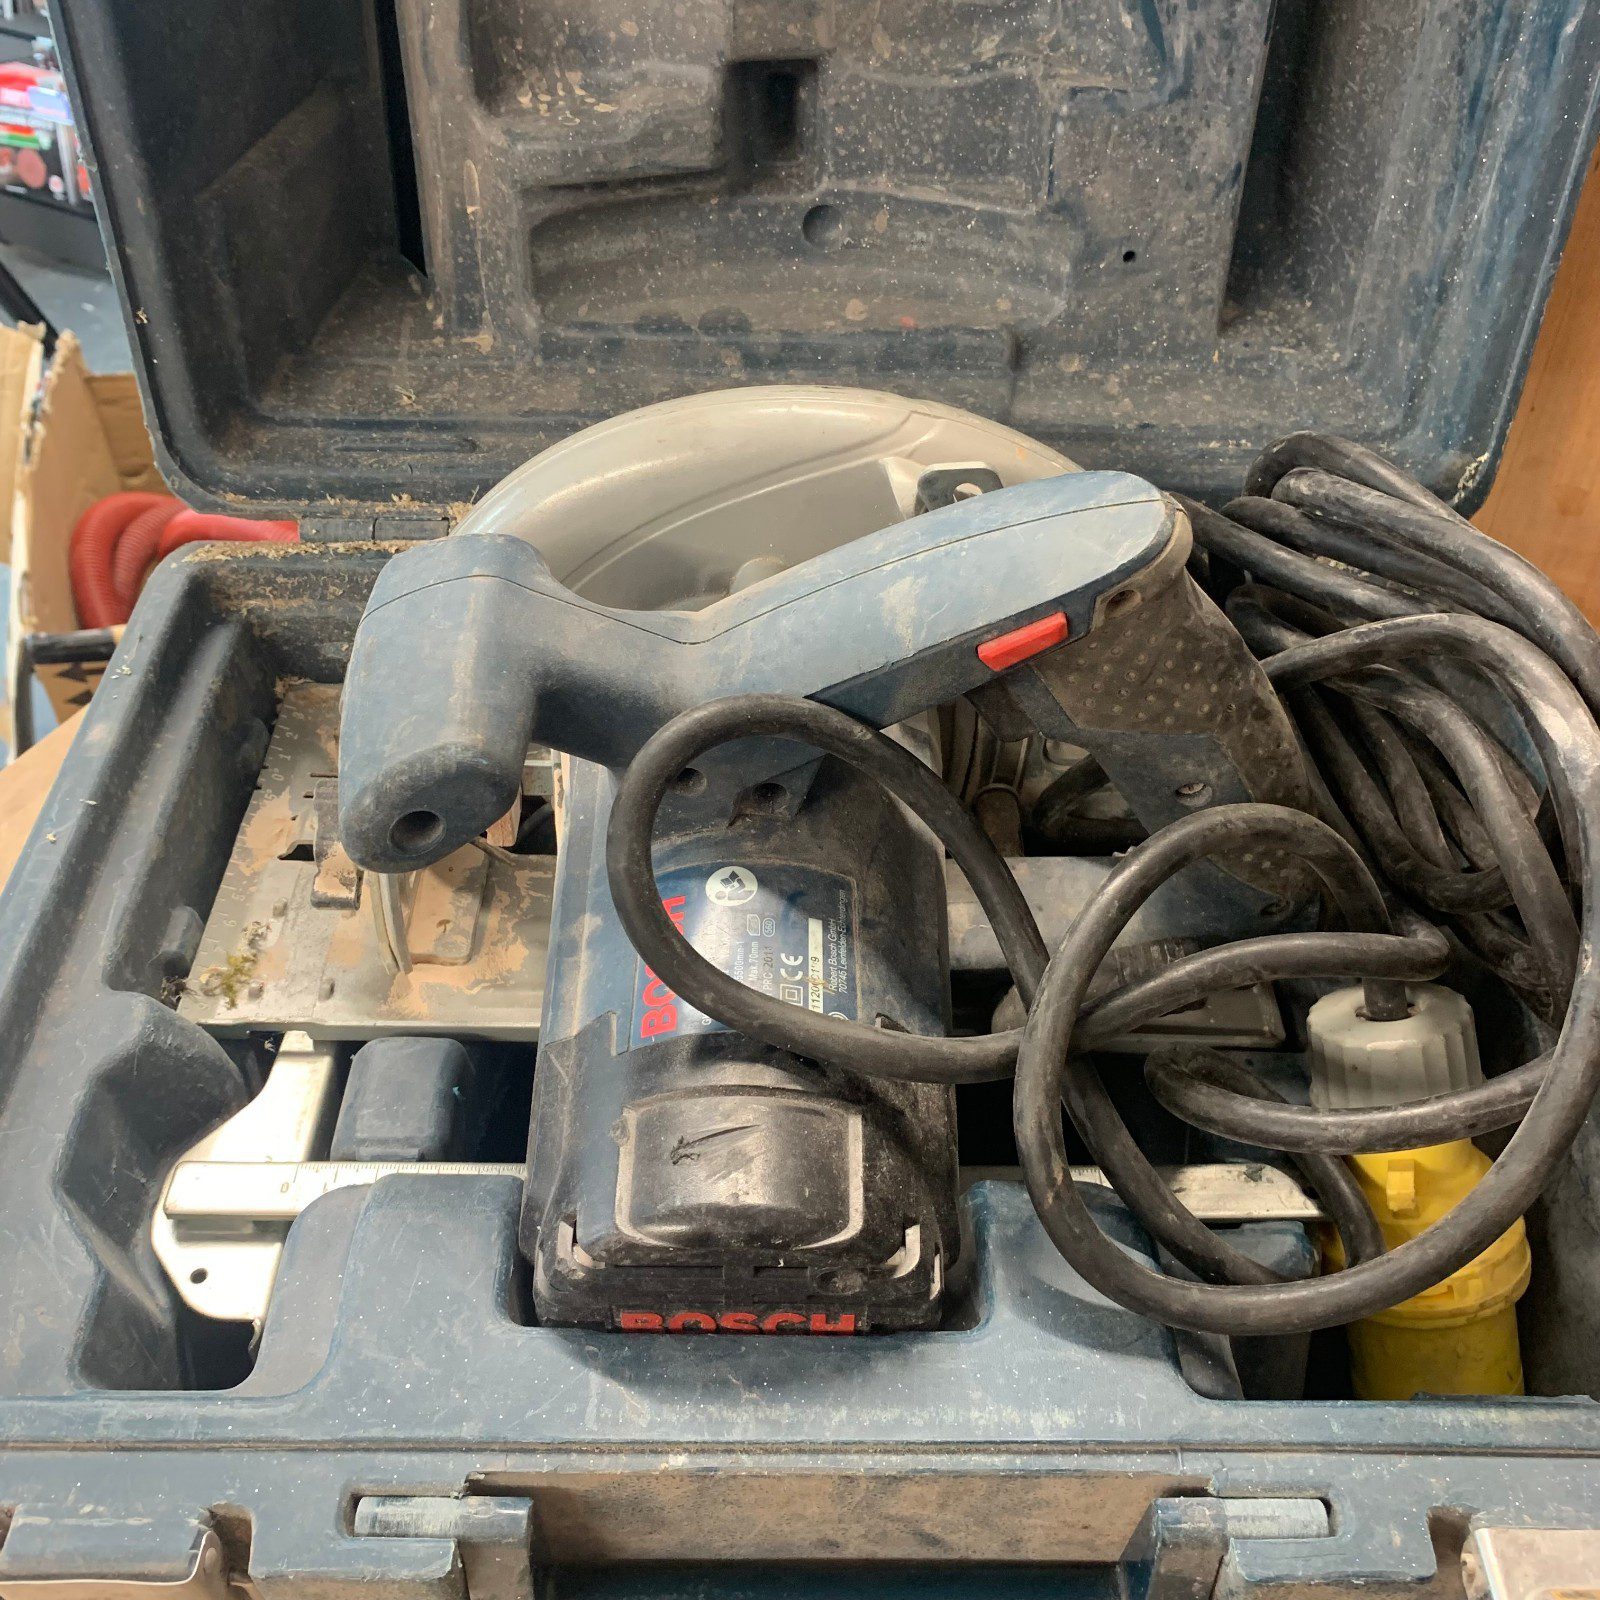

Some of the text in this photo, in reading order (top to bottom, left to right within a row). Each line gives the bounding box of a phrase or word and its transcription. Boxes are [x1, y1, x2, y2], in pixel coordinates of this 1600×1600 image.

[640, 895, 686, 1039] BOH
[762, 971, 774, 991] PRC
[827, 918, 838, 991] Robert Bosch GmbH
